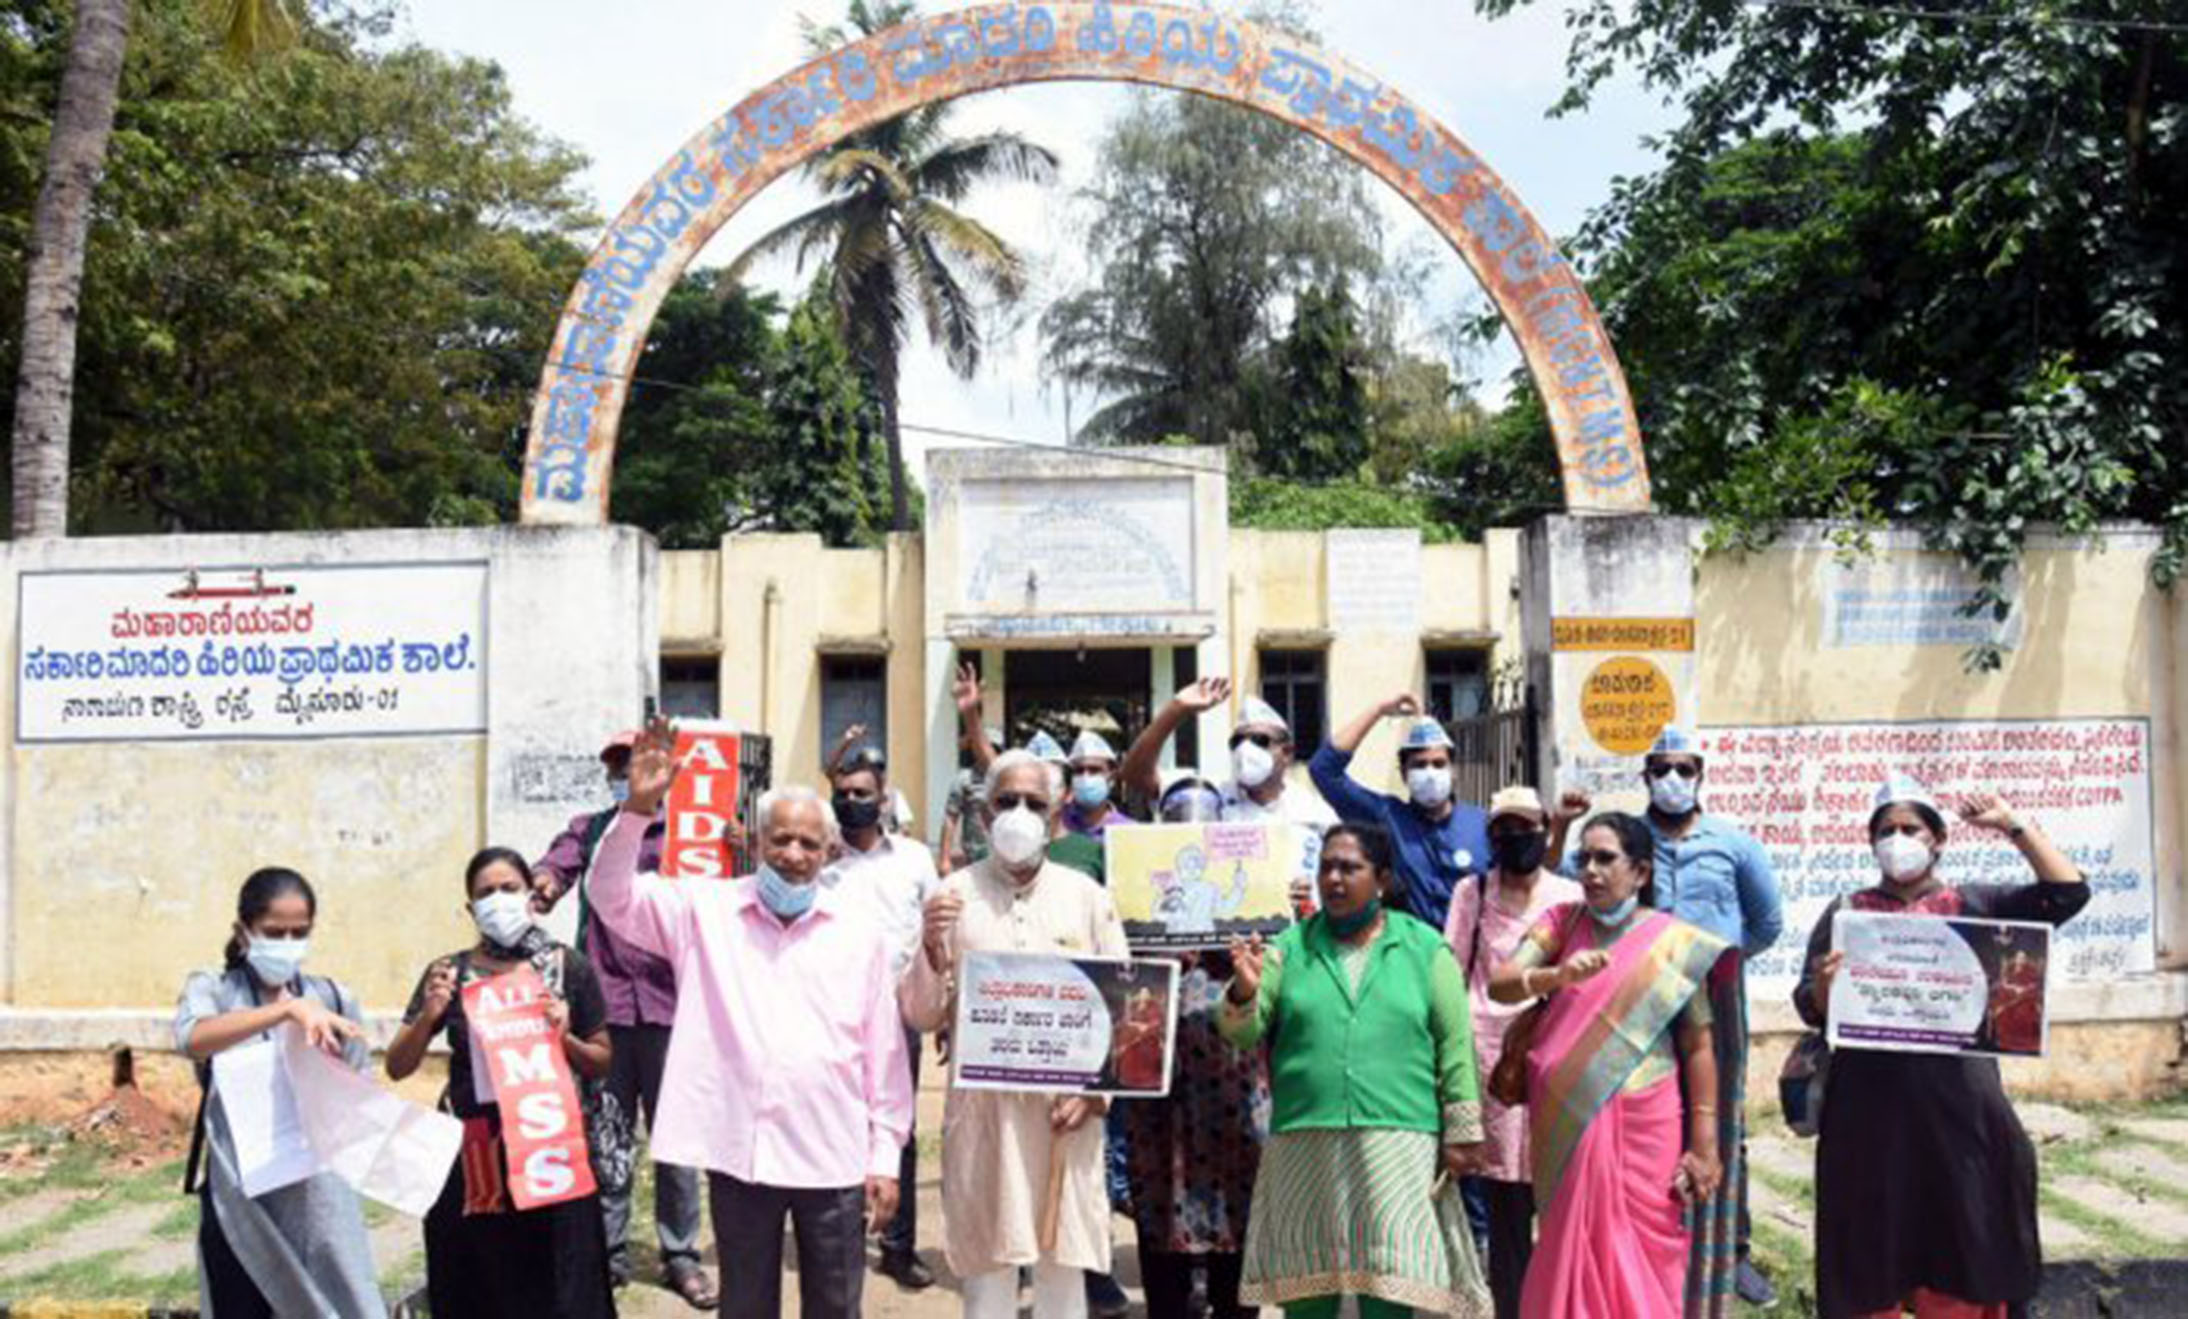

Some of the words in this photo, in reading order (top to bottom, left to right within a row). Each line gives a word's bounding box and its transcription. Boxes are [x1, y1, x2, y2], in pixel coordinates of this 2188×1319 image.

[112, 602, 313, 638] ಮಹಾರಾಣಿಯವರ
[197, 640, 275, 676] ಹಿರಿಯ
[278, 637, 395, 684] ಪ್ರಾಥಮಿಕ
